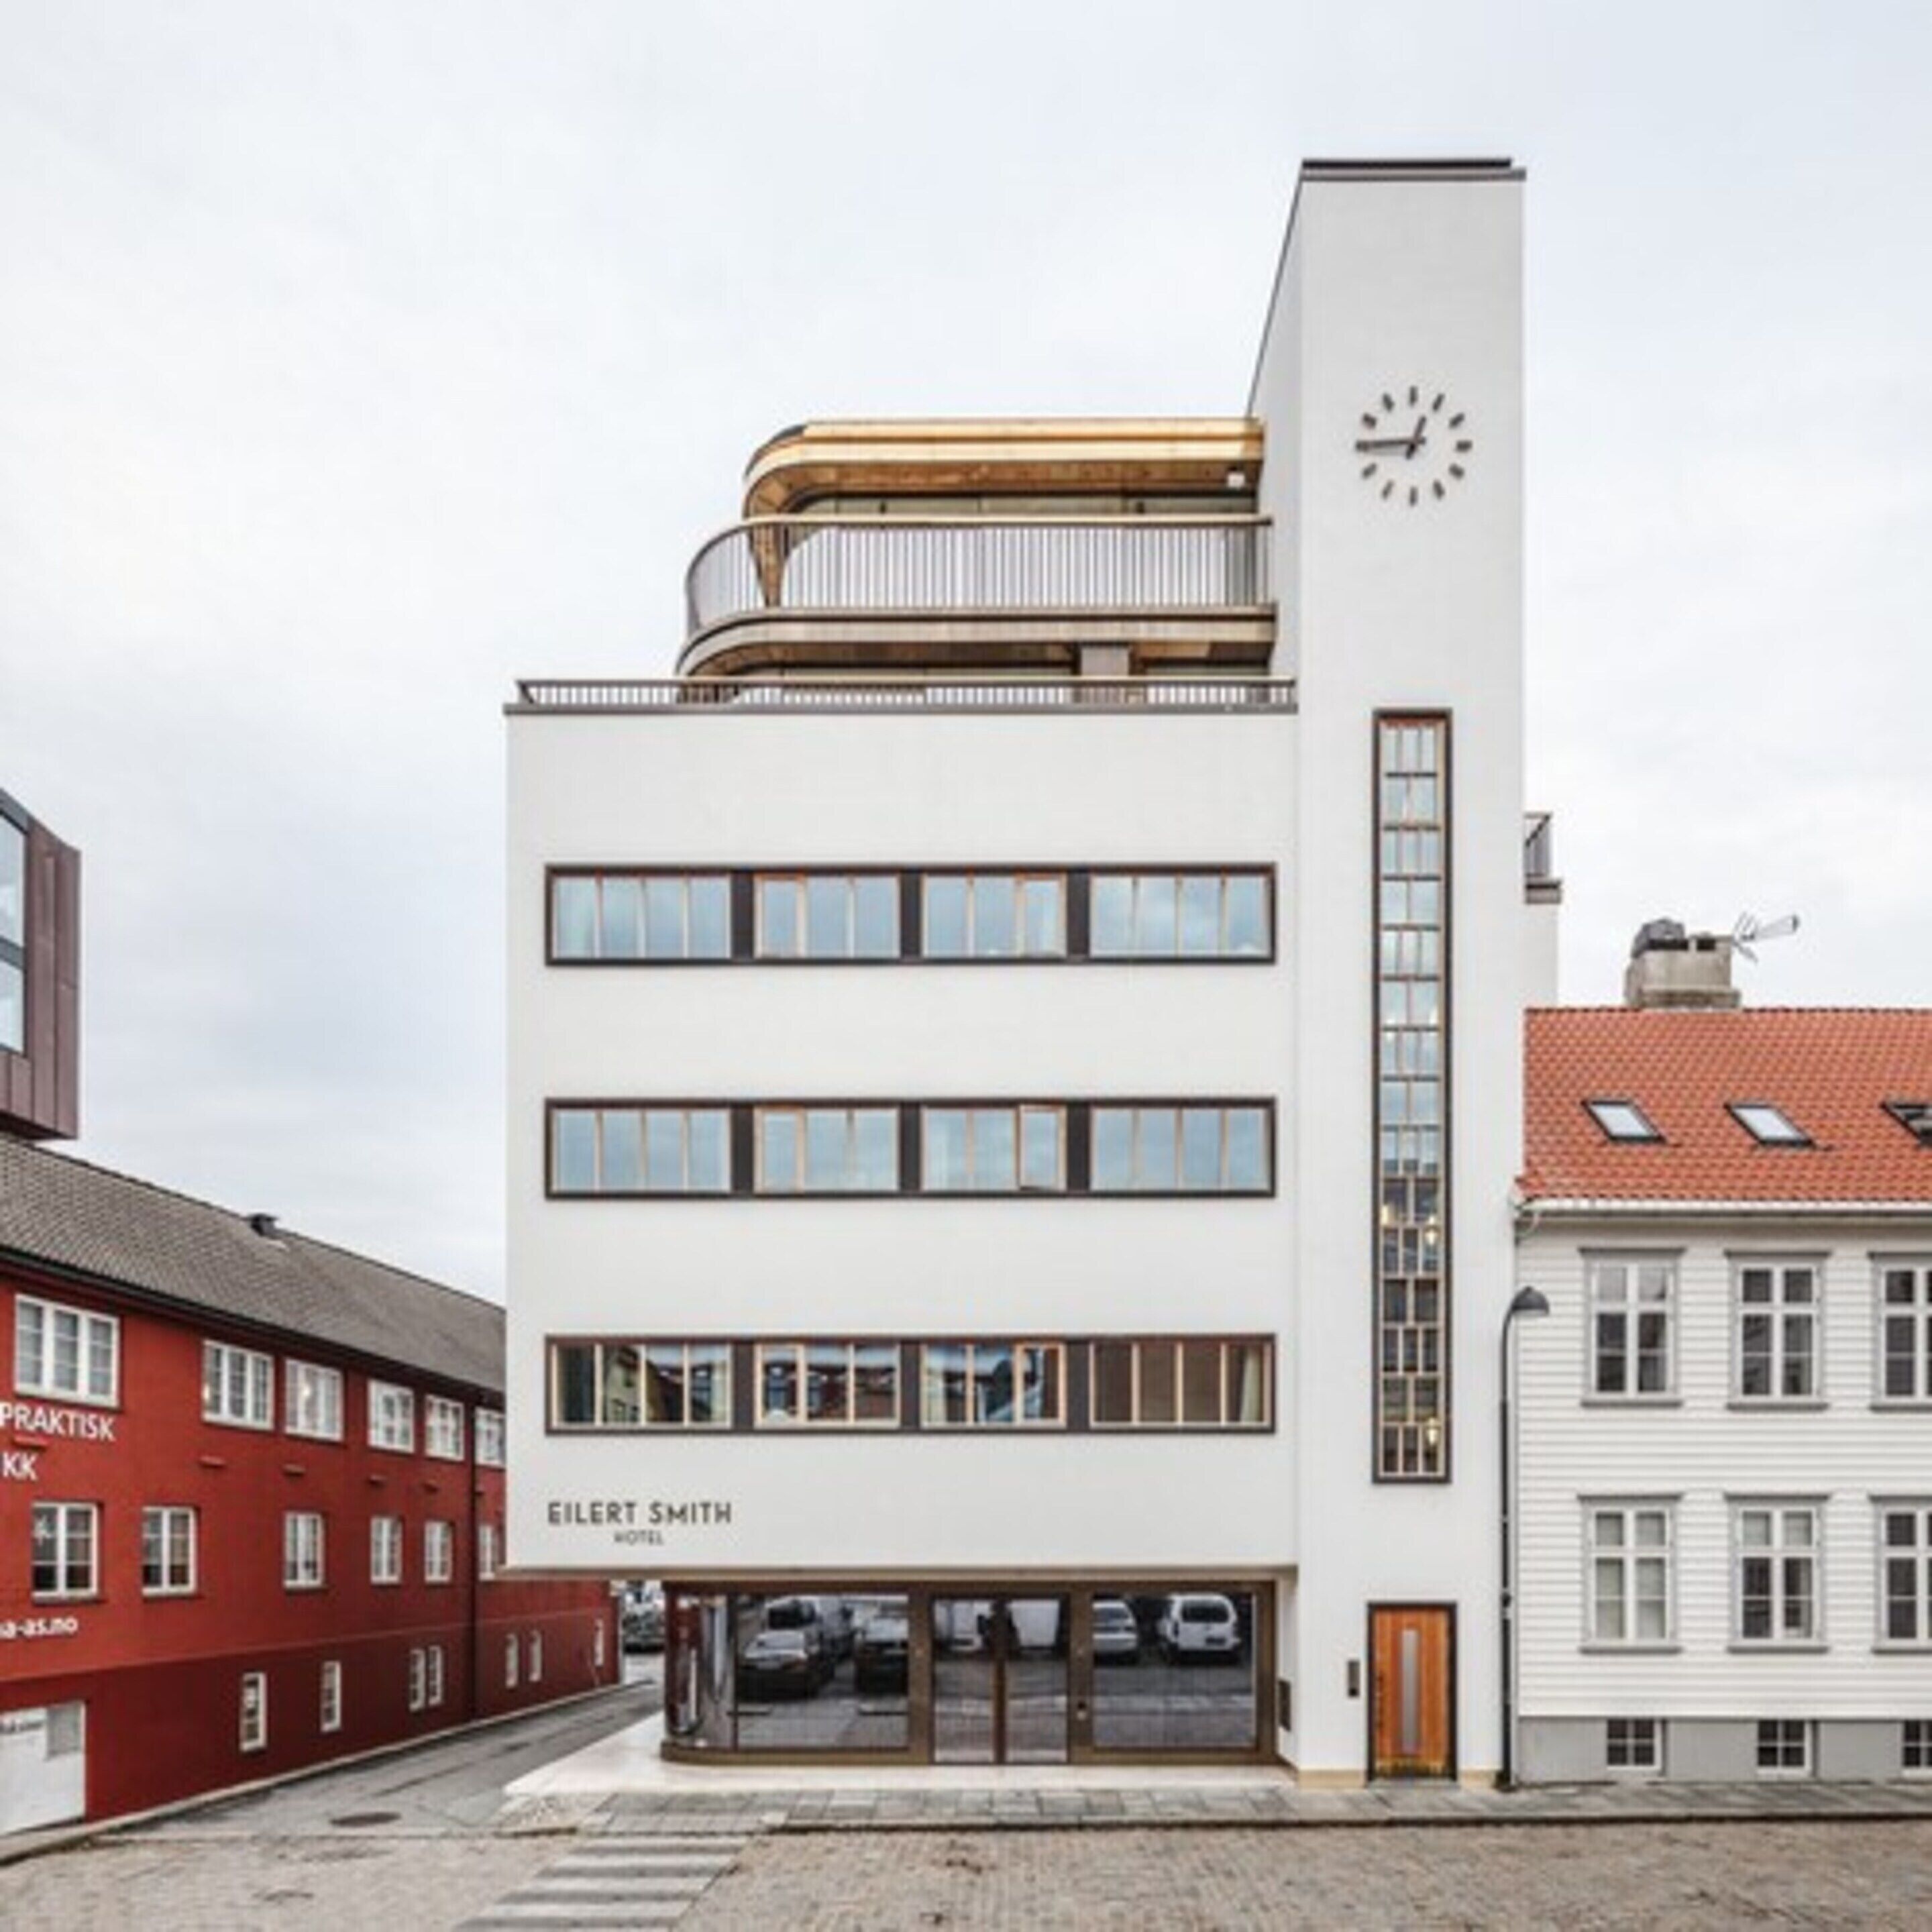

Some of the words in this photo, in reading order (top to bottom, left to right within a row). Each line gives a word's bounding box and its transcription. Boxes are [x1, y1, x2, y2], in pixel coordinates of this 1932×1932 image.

[0, 1401, 115, 1441] PRAKTISK
[547, 1501, 636, 1524] EILERT
[649, 1501, 732, 1524] SMITH
[613, 1529, 664, 1546] HOTEL
[0, 1616, 78, 1638] a-as.no
